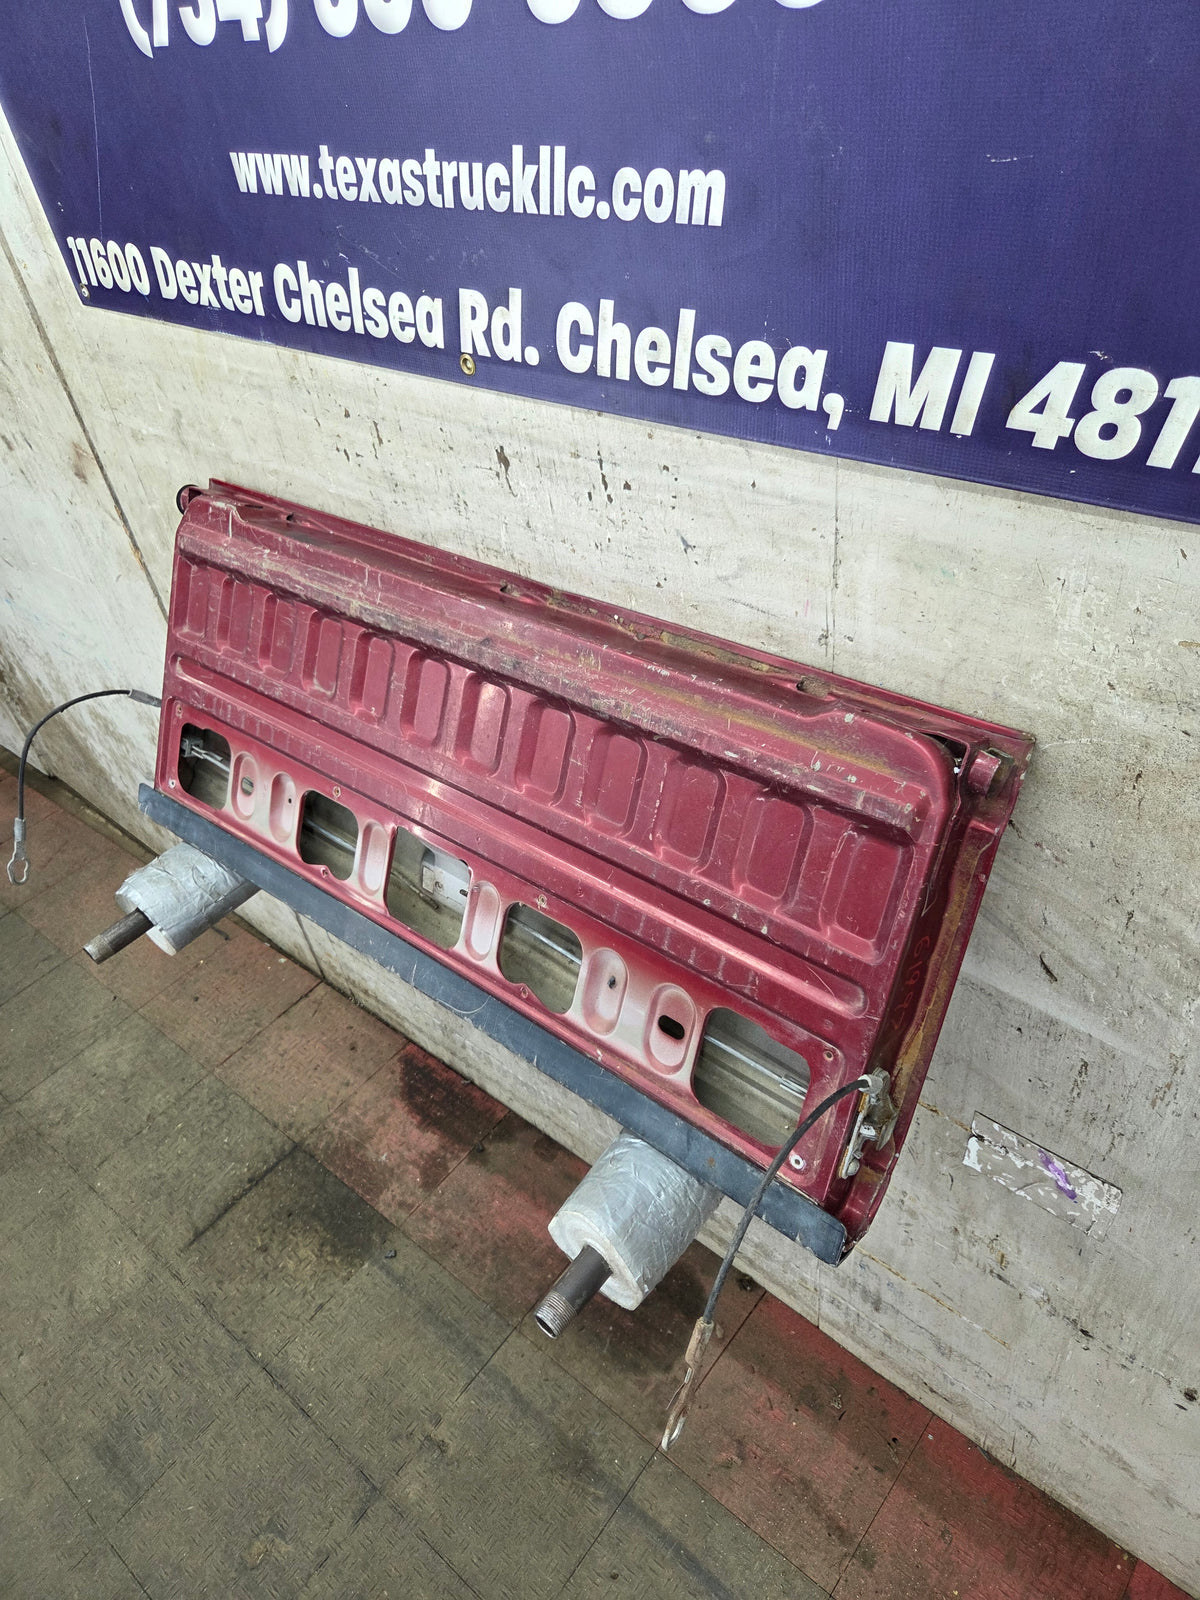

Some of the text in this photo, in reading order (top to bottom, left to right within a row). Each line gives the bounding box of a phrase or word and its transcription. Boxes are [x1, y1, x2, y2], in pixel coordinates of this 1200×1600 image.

[229, 143, 727, 227] www.texastruckllc.com
[66, 235, 1200, 475] 11600 Dexter Chelsea Rd. Chelsea, MI 481
